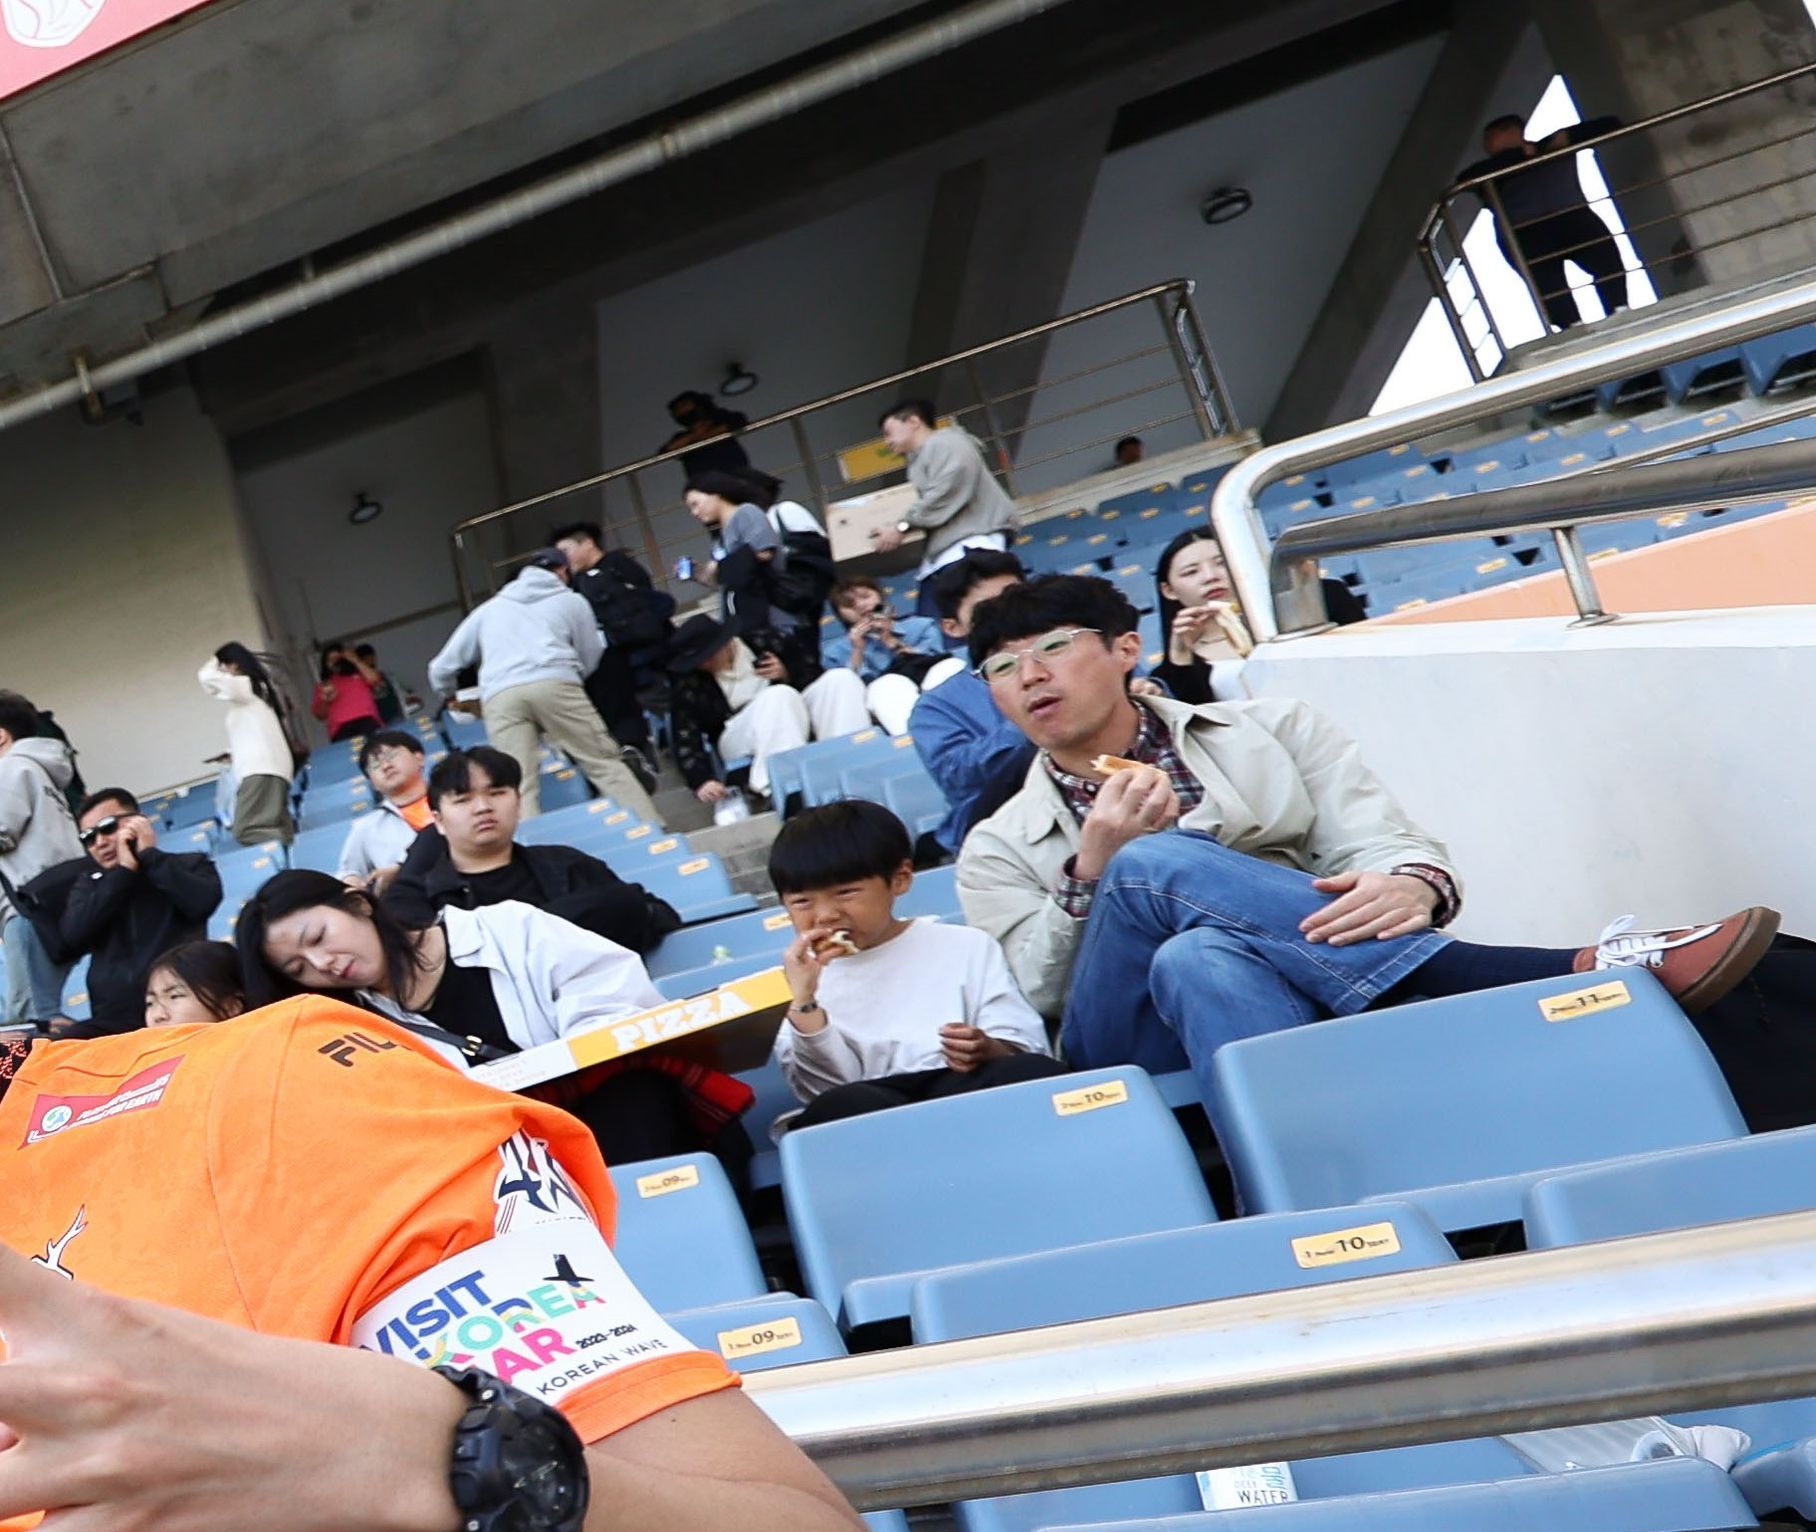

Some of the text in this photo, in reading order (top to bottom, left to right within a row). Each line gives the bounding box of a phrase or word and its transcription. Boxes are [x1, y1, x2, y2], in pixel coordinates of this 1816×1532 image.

[610, 989, 752, 1052] PIZZA
[317, 1031, 414, 1067] FIL
[1336, 1236, 1365, 1252] 10
[358, 1269, 494, 1359] VISIT
[424, 1278, 607, 1369] KOREA
[752, 1330, 774, 1345] 09
[536, 1338, 668, 1396] KOREAN WAVE
[1237, 1489, 1289, 1505] WATER
